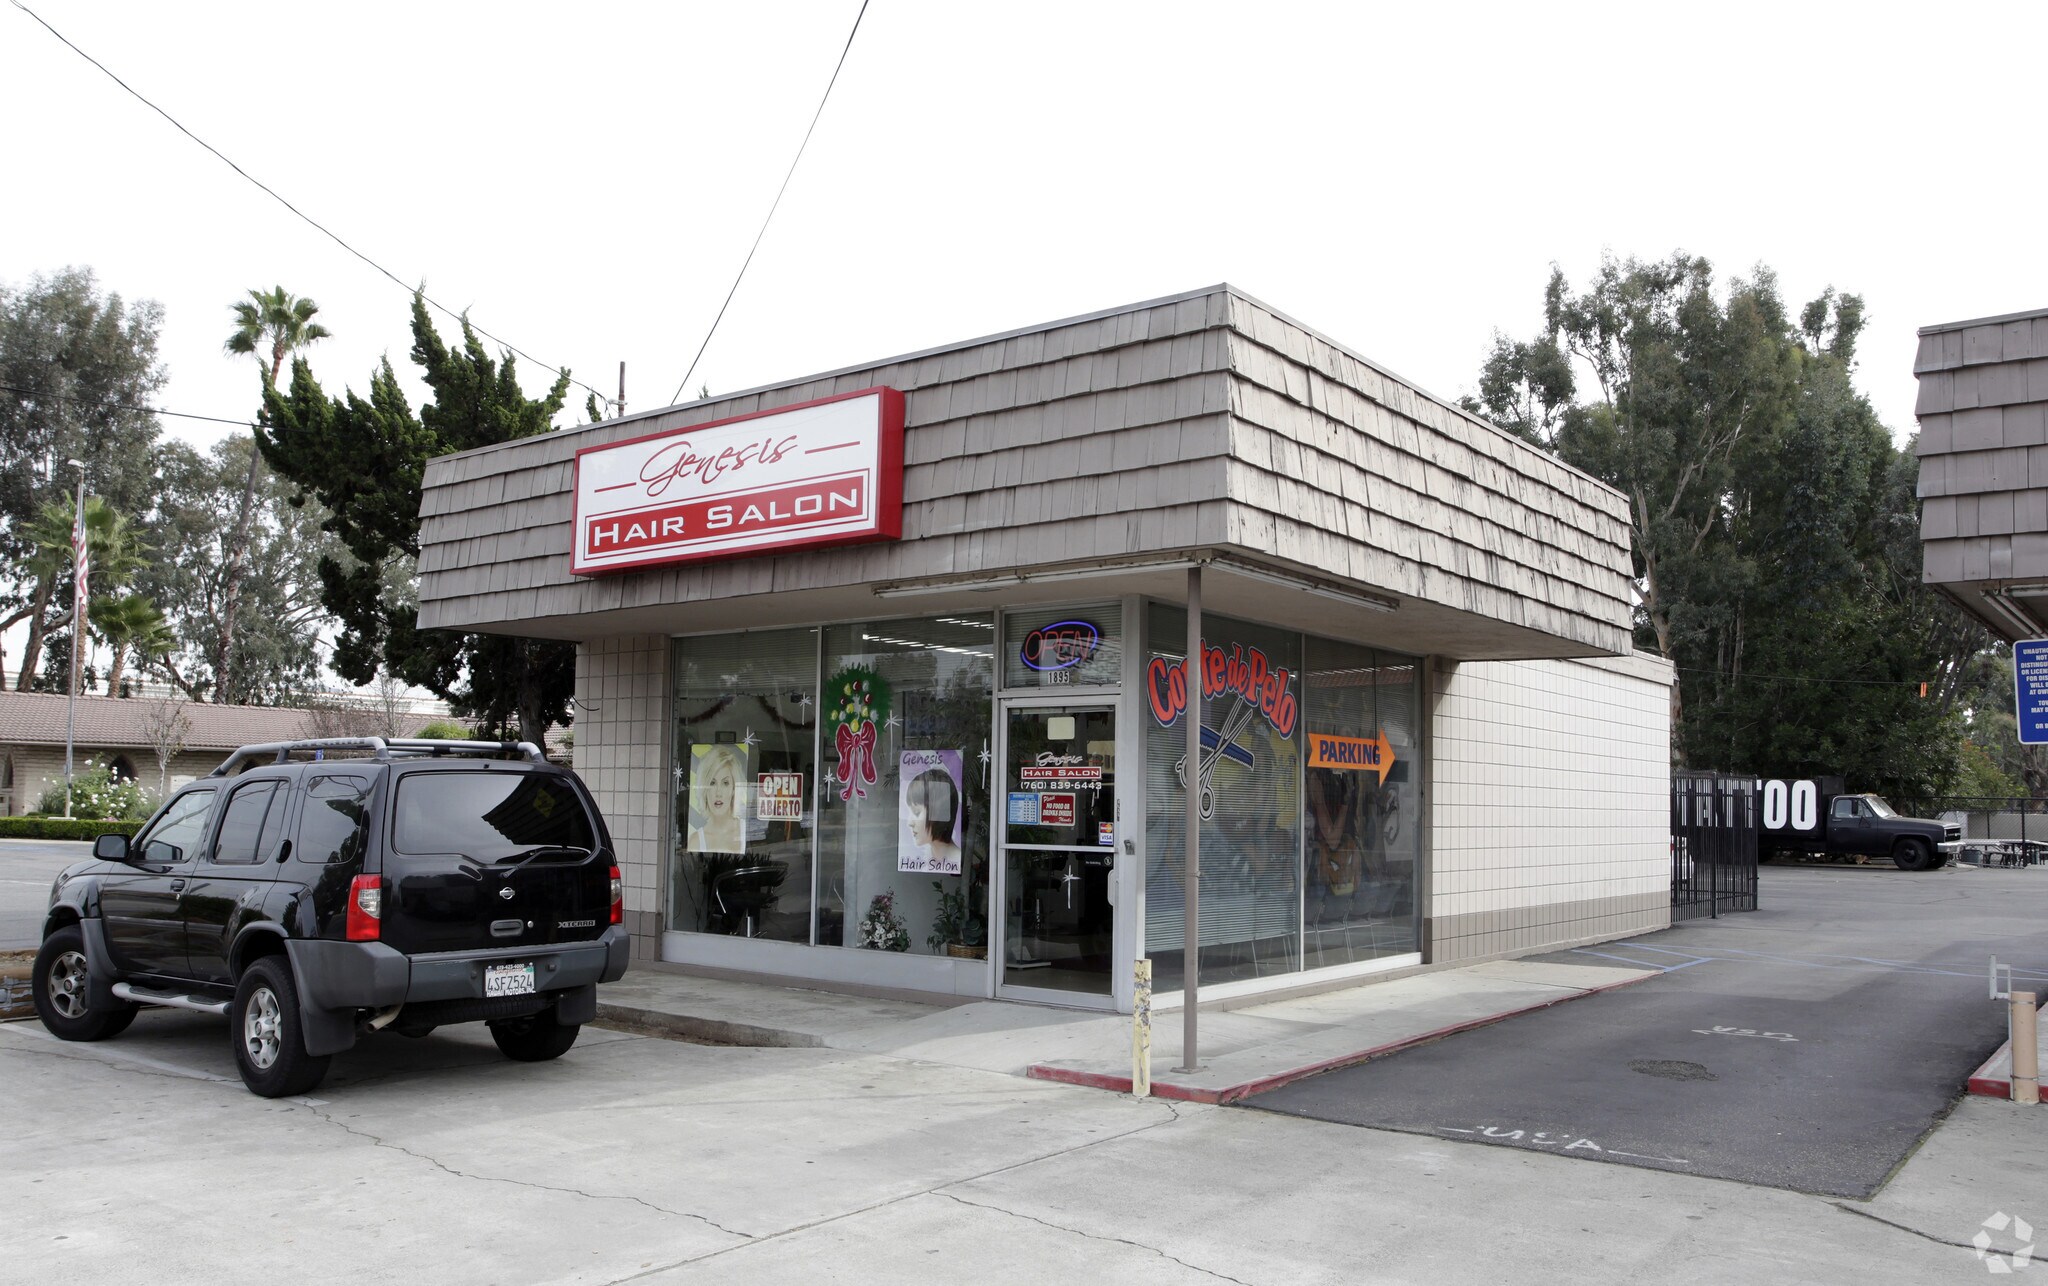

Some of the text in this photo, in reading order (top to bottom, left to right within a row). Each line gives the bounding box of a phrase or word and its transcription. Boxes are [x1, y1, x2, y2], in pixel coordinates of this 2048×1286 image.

[639, 434, 798, 497] Genesis
[593, 488, 858, 547] HAIR SALON
[1025, 630, 1092, 661] OPEN
[1049, 672, 1069, 683] 1895
[1226, 641, 1250, 700] de
[1245, 646, 1298, 741] Pelo
[902, 751, 943, 766] Genesis
[1320, 740, 1381, 765] PARKING
[1024, 769, 1053, 777] HAIR
[763, 776, 798, 795] OPEN
[1020, 781, 1047, 790] (760)
[760, 799, 801, 817] ABIERTO
[901, 857, 959, 871] Hair Salon
[488, 974, 533, 991] 4SFZ524
